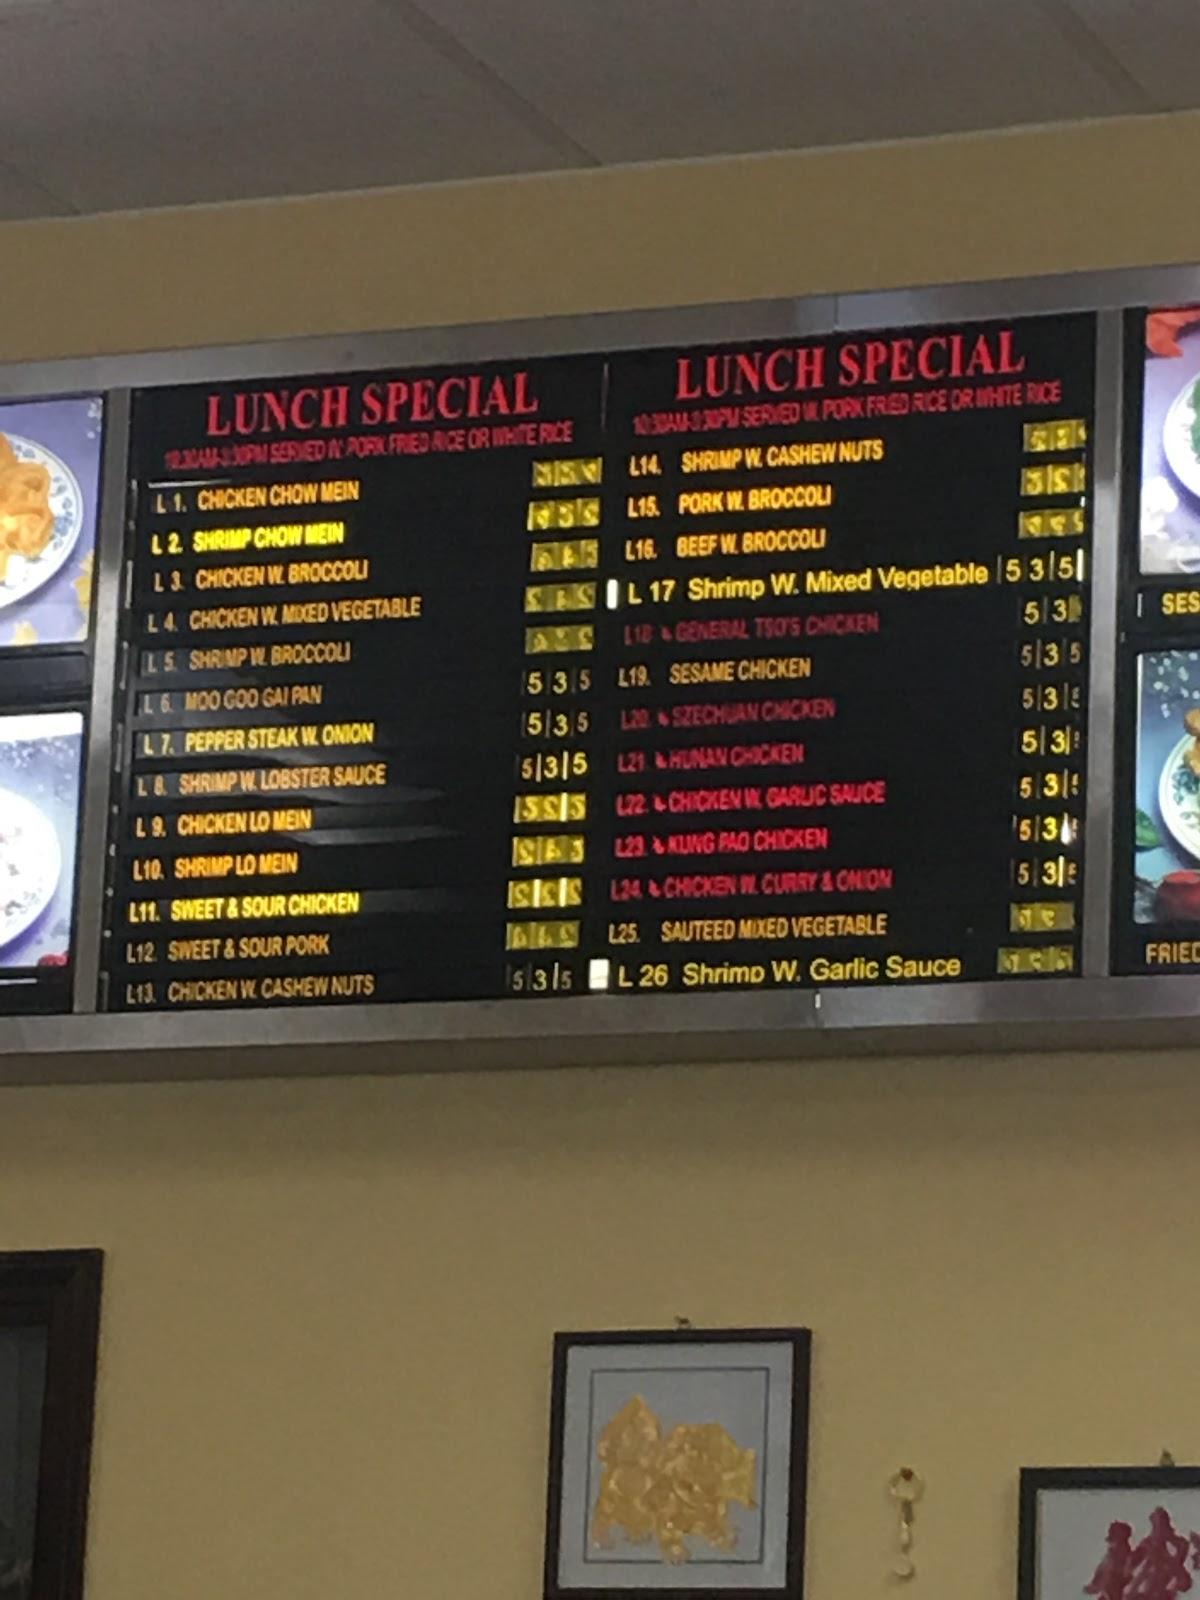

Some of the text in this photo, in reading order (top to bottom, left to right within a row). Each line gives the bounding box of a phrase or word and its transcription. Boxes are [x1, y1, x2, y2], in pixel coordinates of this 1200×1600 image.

[676, 330, 1025, 400] LUNCH SPECIAL
[207, 372, 538, 435] LUNCH SPECIAL
[976, 385, 1022, 408] WHITE
[681, 449, 741, 473] SHRIMP
[767, 443, 836, 466] CASHEW
[839, 440, 883, 461] NUTS
[157, 495, 166, 514] L
[198, 488, 266, 511] CHICKEN
[270, 483, 317, 506] CHOW
[320, 481, 360, 501] MEIN
[678, 493, 723, 515] PORK
[748, 485, 832, 510] BROCCOLI
[152, 535, 162, 555] L
[193, 528, 251, 552] SHRIMP
[254, 525, 303, 548] CHOW
[305, 522, 344, 544] MEIN
[677, 534, 718, 557] BEEF
[743, 529, 826, 553] BROCCOLI
[155, 573, 164, 592] L
[196, 567, 265, 589] CHICKEN
[288, 559, 369, 582] BROCCOLI
[628, 583, 642, 604] L
[650, 580, 676, 602] 17
[688, 575, 765, 600] Shrimp
[806, 568, 872, 593] Mixed
[878, 562, 988, 590] Vegetable
[149, 614, 158, 633] L
[190, 608, 259, 631] CHICKEN
[282, 602, 328, 623] MIXED
[331, 596, 421, 621] VEGETABLE
[148, 654, 157, 673] L
[189, 648, 247, 670] SHRIMP
[271, 641, 350, 664] BROCCOLI
[669, 662, 734, 685] SESAME
[738, 658, 811, 680] CHICKEN
[144, 695, 153, 714] L
[185, 690, 220, 711] MOO
[224, 688, 259, 708] GOO
[263, 687, 289, 706] GAI
[292, 685, 322, 704] PAN
[144, 736, 154, 754] L
[185, 730, 245, 752] PEPPER
[248, 726, 298, 749] STEAK
[322, 722, 374, 744] ONION
[138, 778, 147, 796] L
[179, 772, 237, 794] SHRIMP
[261, 767, 330, 789] LOBSTER
[334, 763, 387, 785] SAUCE
[668, 788, 742, 812] CHICKEN
[766, 784, 827, 808] GARLIC
[830, 781, 886, 803] SAUCE
[136, 818, 146, 837] L
[178, 813, 247, 835] CHICKEN
[250, 812, 270, 831] LO
[273, 809, 313, 830] MEIN
[667, 831, 715, 855] KUNG
[754, 828, 828, 850] CHICKEN
[175, 855, 233, 878] SHRIMP
[236, 855, 256, 875] LO
[259, 853, 298, 874] MEIN
[664, 875, 735, 898] CHICKEN
[761, 871, 817, 894] CURRY
[171, 897, 224, 921] SWEET
[227, 897, 239, 917] &
[242, 896, 286, 917] SOUR
[289, 893, 359, 915] CHICKEN
[661, 919, 735, 942] SAUTEED
[738, 917, 788, 938] MIXED
[791, 913, 887, 937] VEGETABLE
[168, 938, 220, 961] SWEET
[224, 938, 235, 959] &
[239, 937, 283, 958] SOUR
[285, 934, 329, 955] PORK
[618, 966, 632, 987] L
[640, 964, 668, 986] 26
[810, 958, 879, 981] Garlic
[885, 955, 961, 978] Sauce
[168, 979, 237, 1001] CHICKEN
[261, 977, 328, 997] CASHEW
[331, 974, 375, 994] NUTS
